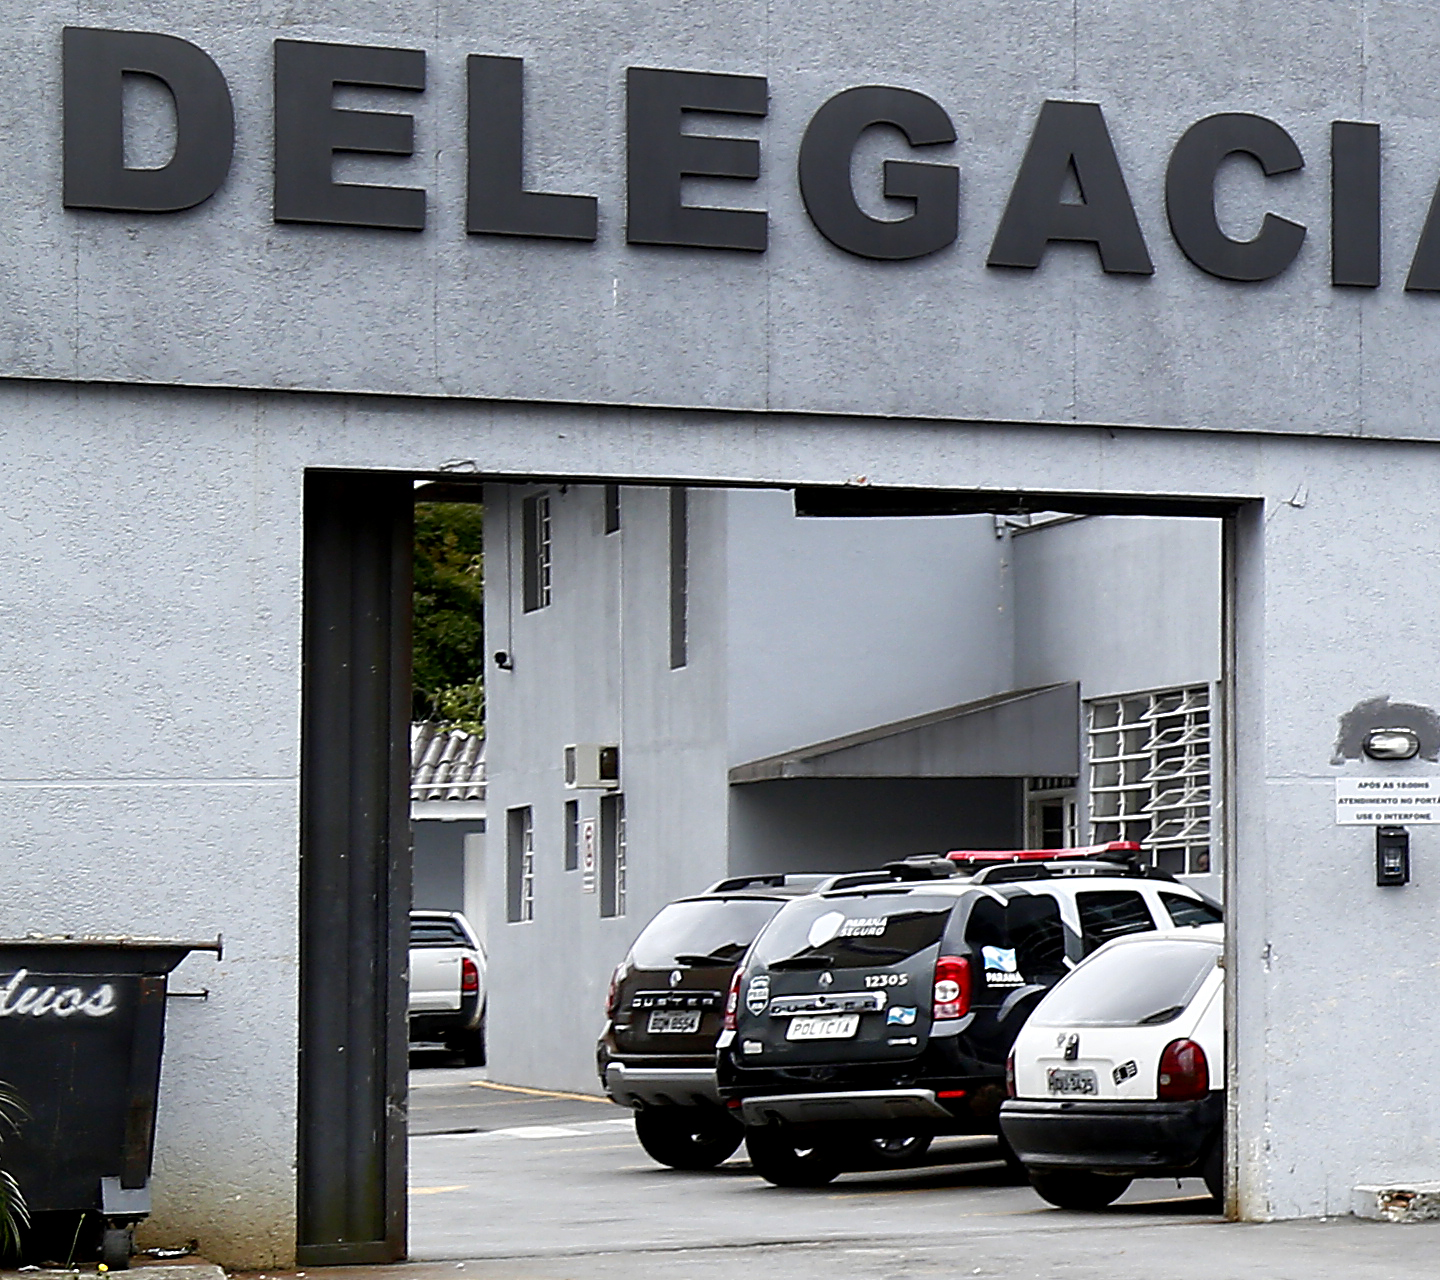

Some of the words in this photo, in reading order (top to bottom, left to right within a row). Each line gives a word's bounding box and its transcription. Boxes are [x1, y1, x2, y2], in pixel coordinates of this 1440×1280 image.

[1338, 797, 1399, 805] ATENDIMENTO
[1400, 797, 1413, 805] NO
[1383, 813, 1432, 821] INTERFONE
[864, 973, 909, 988] 12305
